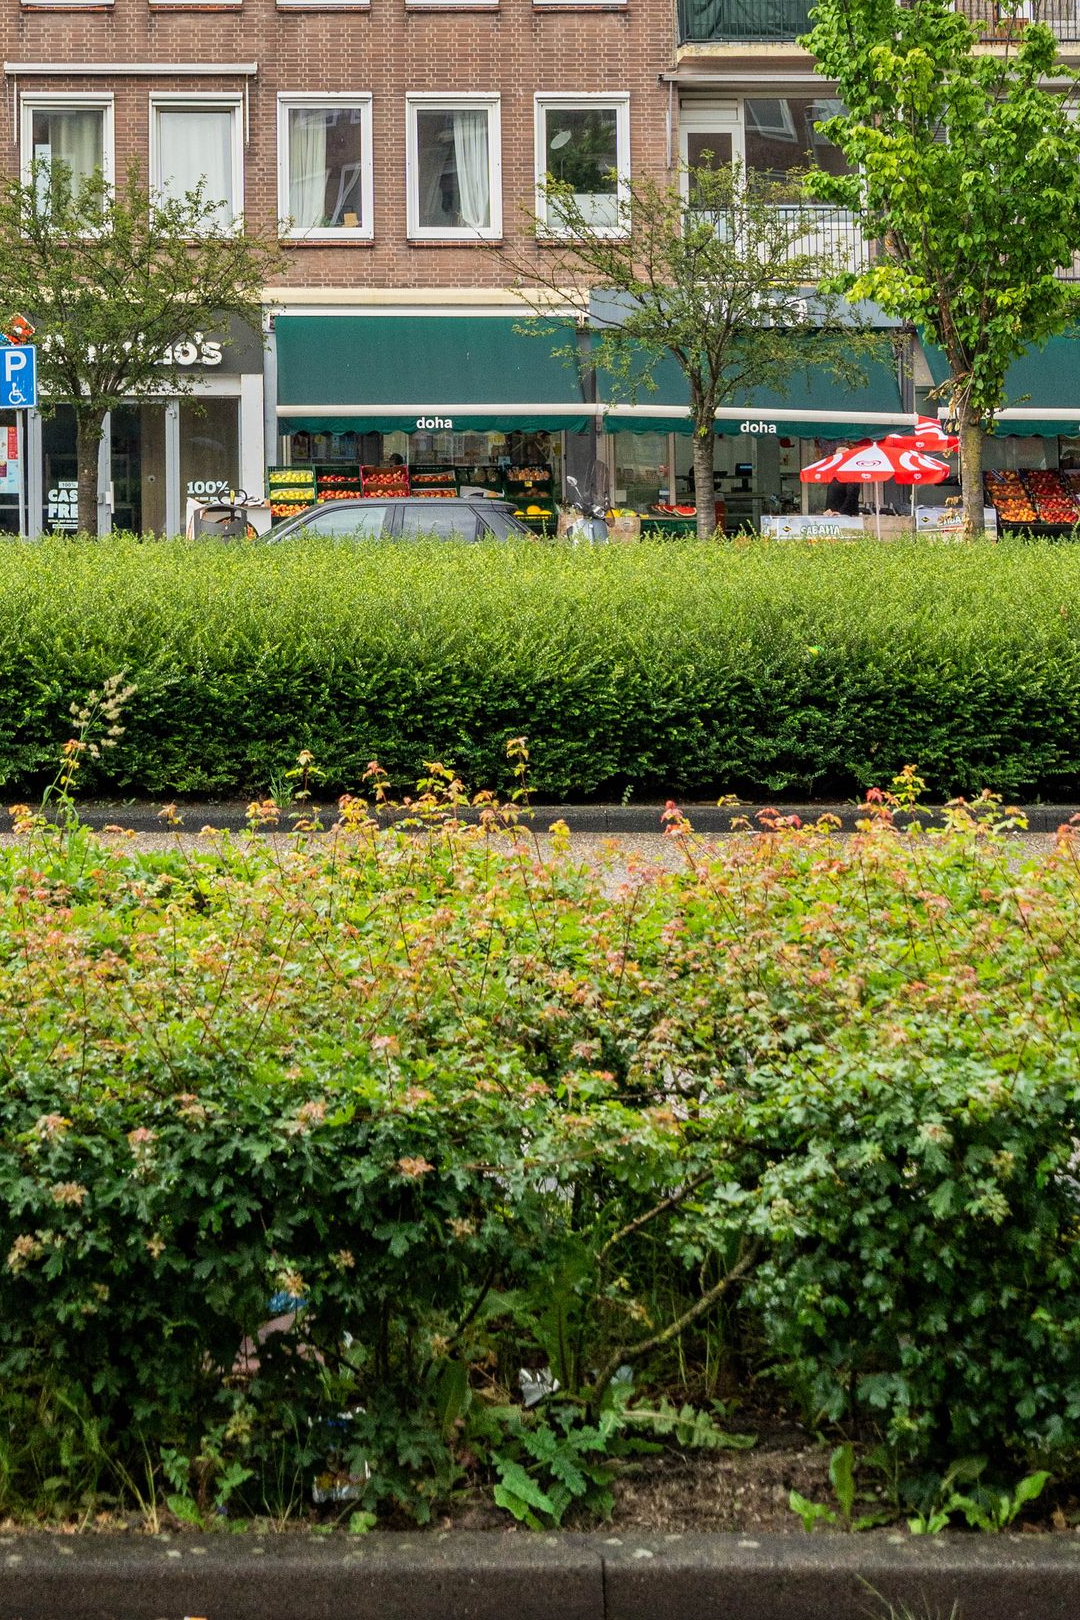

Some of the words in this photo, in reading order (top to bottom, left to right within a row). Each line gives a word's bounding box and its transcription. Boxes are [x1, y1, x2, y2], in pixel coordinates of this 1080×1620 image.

[5, 351, 27, 382] P
[416, 416, 453, 429] doha
[740, 420, 777, 434] doha
[186, 480, 230, 494] 100%
[48, 489, 79, 502] CAS
[48, 503, 79, 518] FRE
